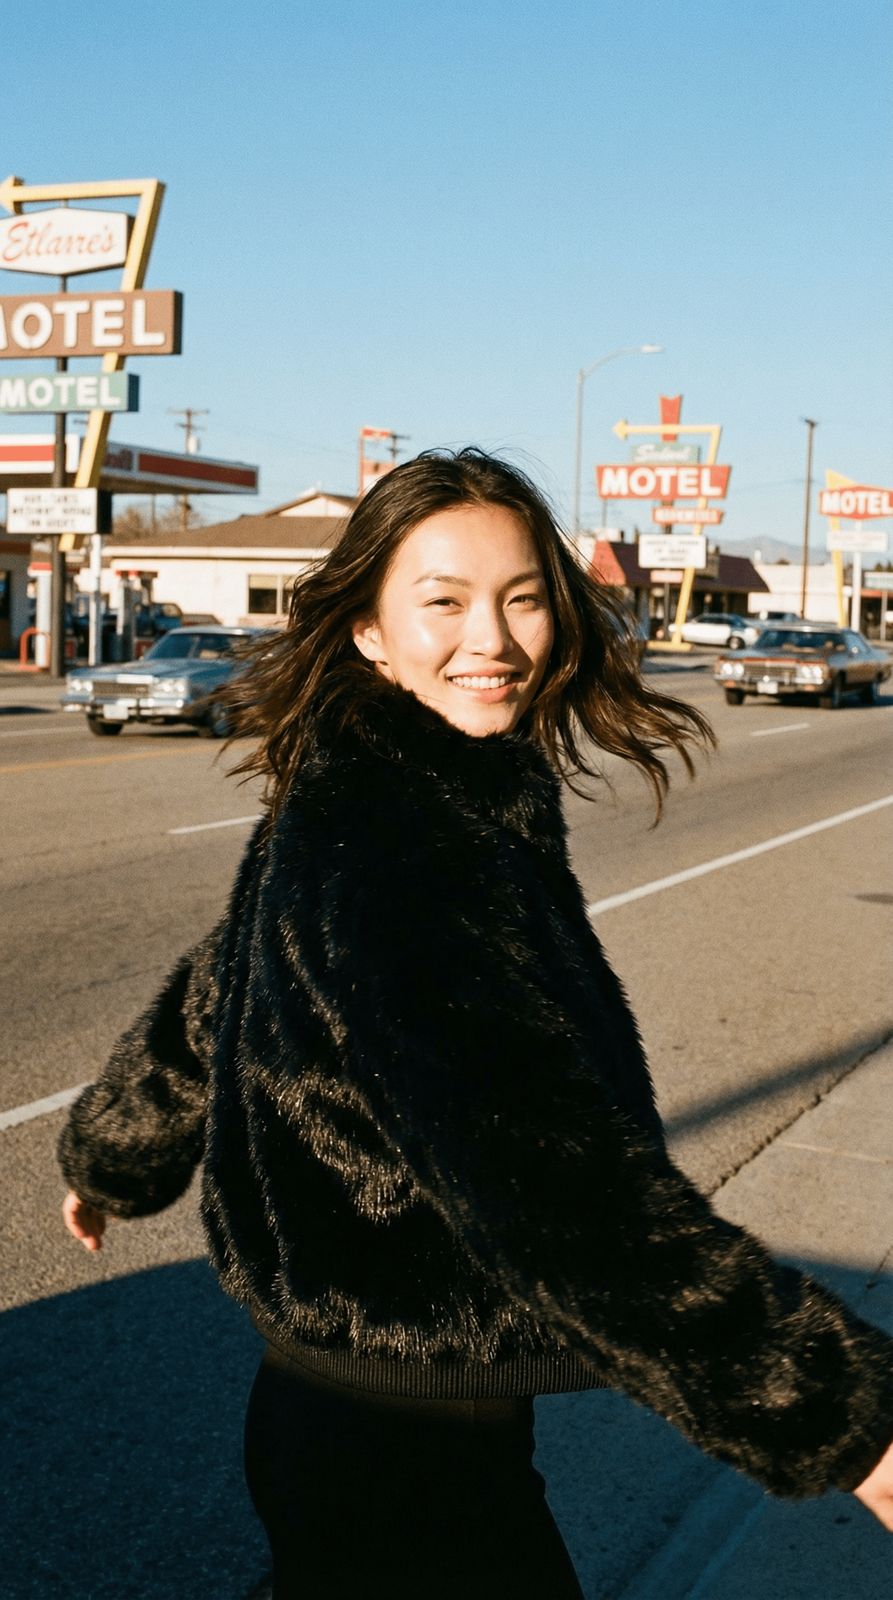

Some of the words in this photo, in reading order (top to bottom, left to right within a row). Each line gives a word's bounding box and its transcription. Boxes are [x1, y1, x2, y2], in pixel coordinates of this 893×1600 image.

[0, 298, 165, 350] OTEL
[0, 375, 121, 407] MOTEL
[600, 467, 722, 496] MOTEL
[821, 490, 893, 515] MOTEL
